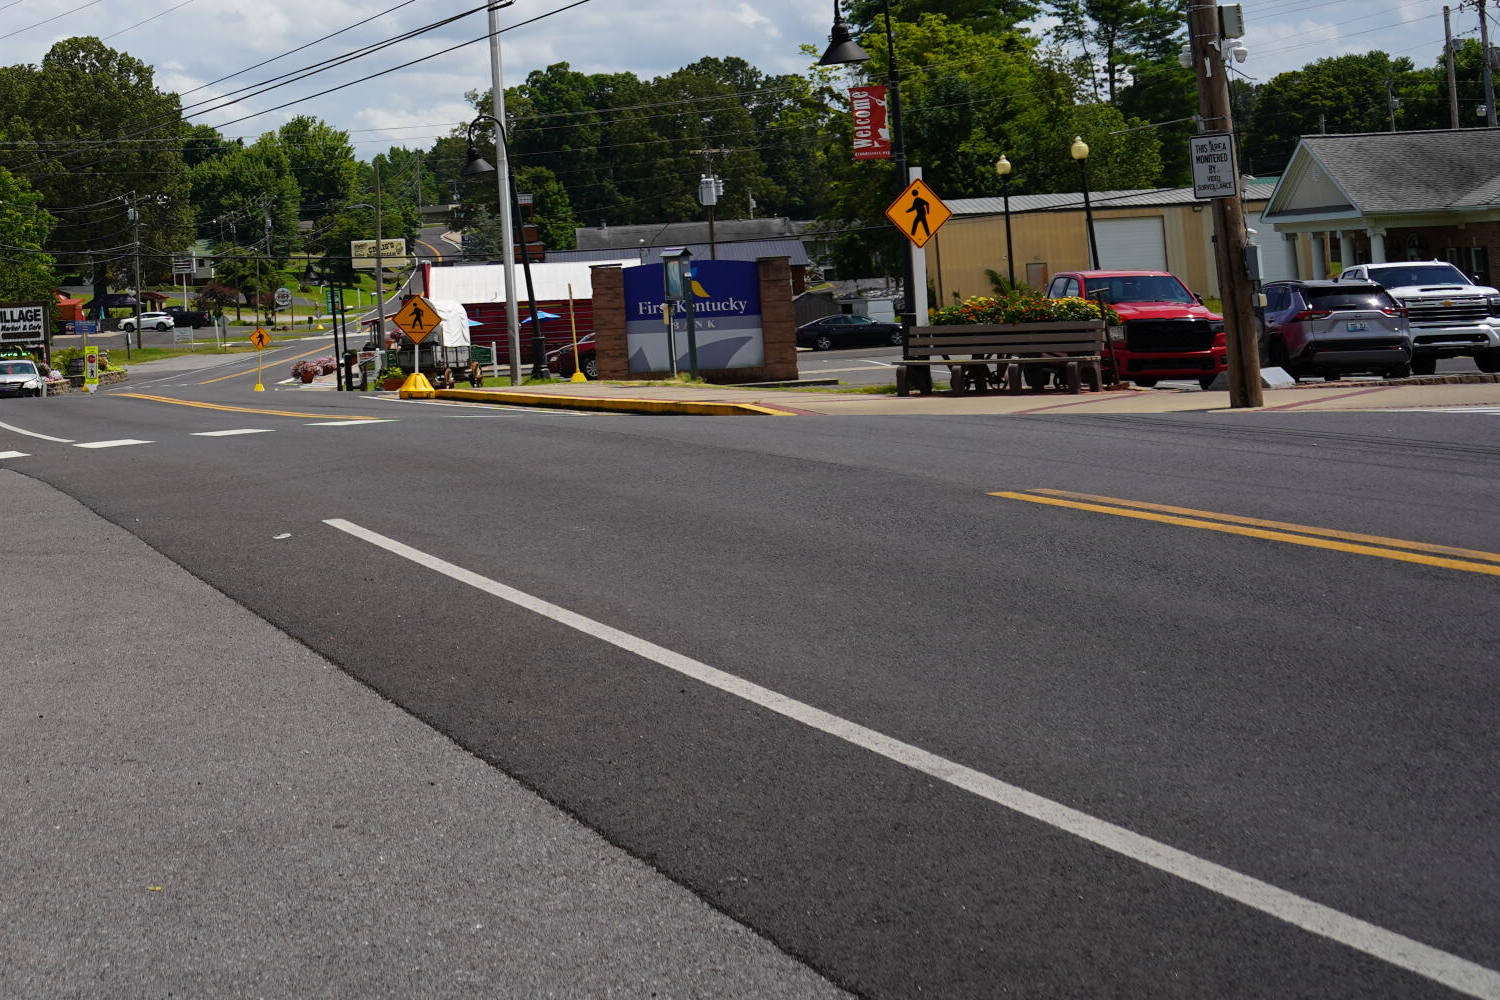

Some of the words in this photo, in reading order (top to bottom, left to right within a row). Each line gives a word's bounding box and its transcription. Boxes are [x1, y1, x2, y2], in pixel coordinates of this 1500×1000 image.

[852, 91, 873, 149] Welcome
[1195, 144, 1208, 153] THIS
[1210, 143, 1227, 152] AREA
[1196, 153, 1228, 164] MONITERED
[1208, 165, 1217, 174] BY
[1197, 183, 1232, 191] SURVEILLANCE
[638, 301, 677, 315] Firs
[676, 297, 748, 314] Kentucky
